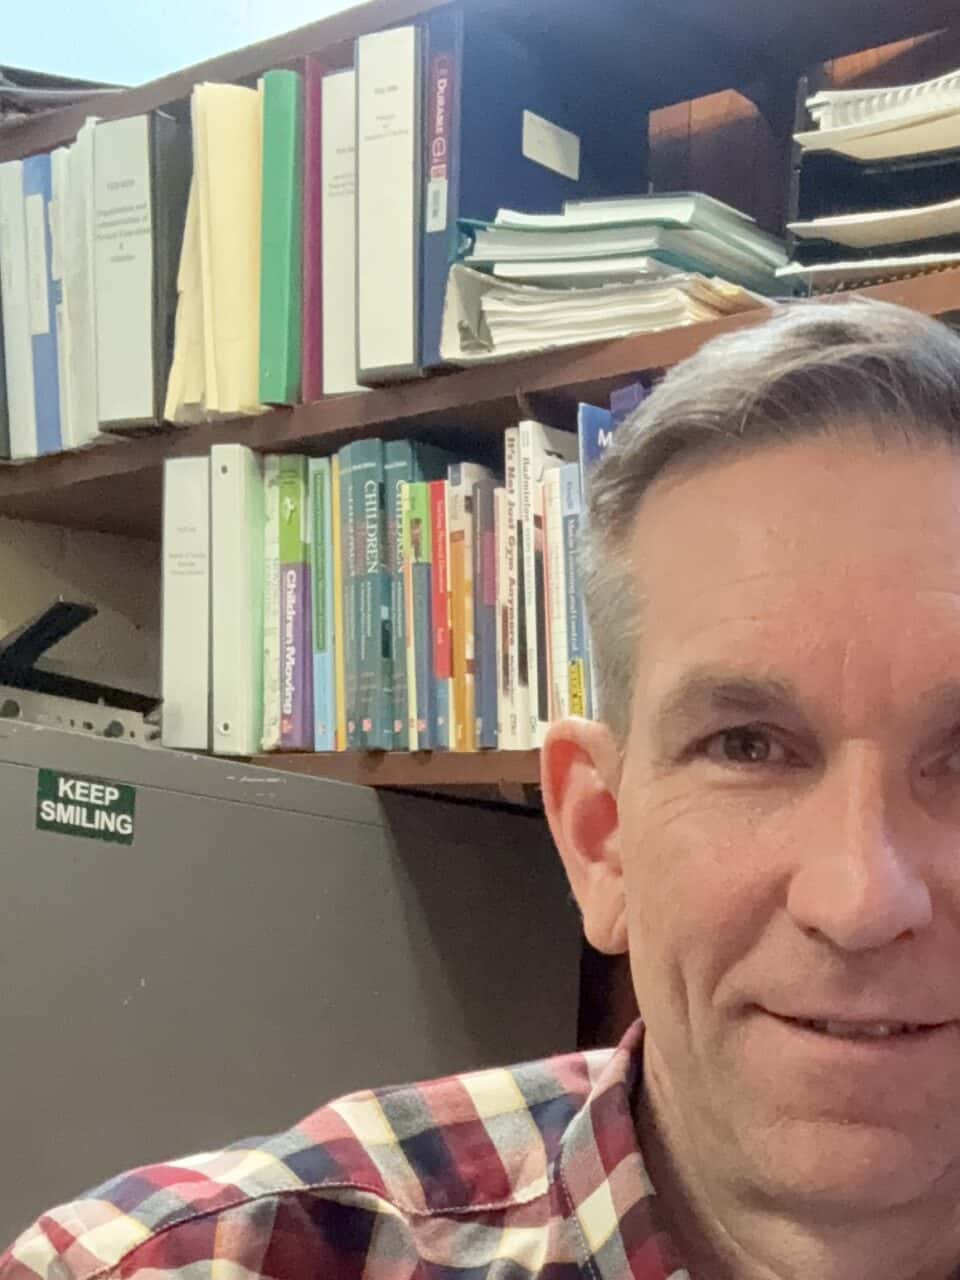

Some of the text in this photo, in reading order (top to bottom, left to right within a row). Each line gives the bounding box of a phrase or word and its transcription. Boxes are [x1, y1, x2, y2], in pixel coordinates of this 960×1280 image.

[364, 480, 379, 573] CHILDREN
[507, 501, 516, 530] Just
[505, 535, 516, 571] Gym
[508, 577, 516, 647] Anymore
[282, 569, 298, 715] Children Moving
[571, 613, 580, 651] Control
[58, 777, 120, 806] KEEP
[40, 800, 133, 836] SMILING
